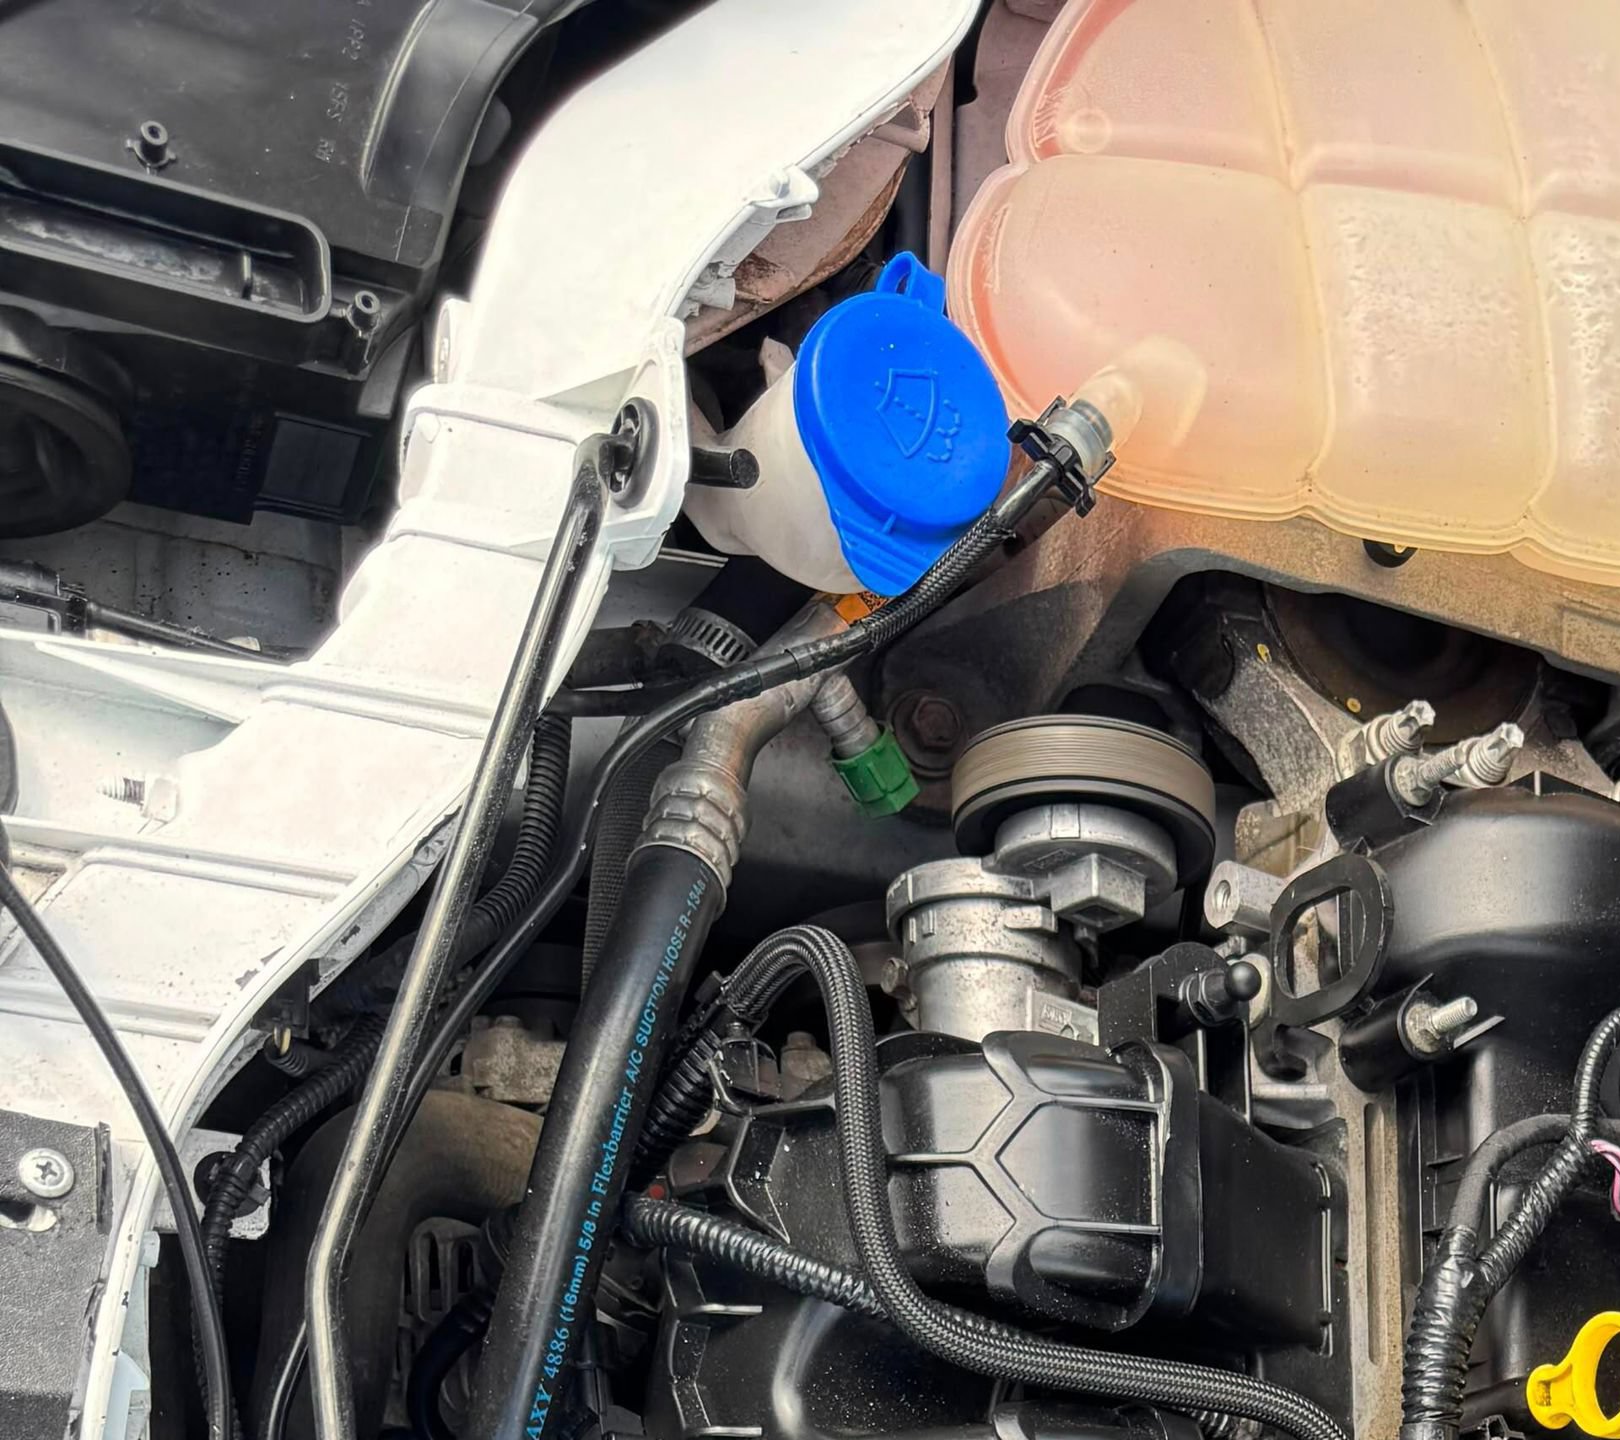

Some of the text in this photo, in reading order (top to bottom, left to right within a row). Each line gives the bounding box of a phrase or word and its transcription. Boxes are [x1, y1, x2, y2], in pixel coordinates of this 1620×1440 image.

[662, 924, 689, 974] HOSE
[634, 969, 671, 1049] SUCTION
[625, 1047, 645, 1084] A/C
[591, 1086, 636, 1198] Flexbarrier
[577, 1217, 598, 1253] 5/8
[560, 1252, 592, 1325] (16mm)
[546, 1320, 572, 1383] 4886
